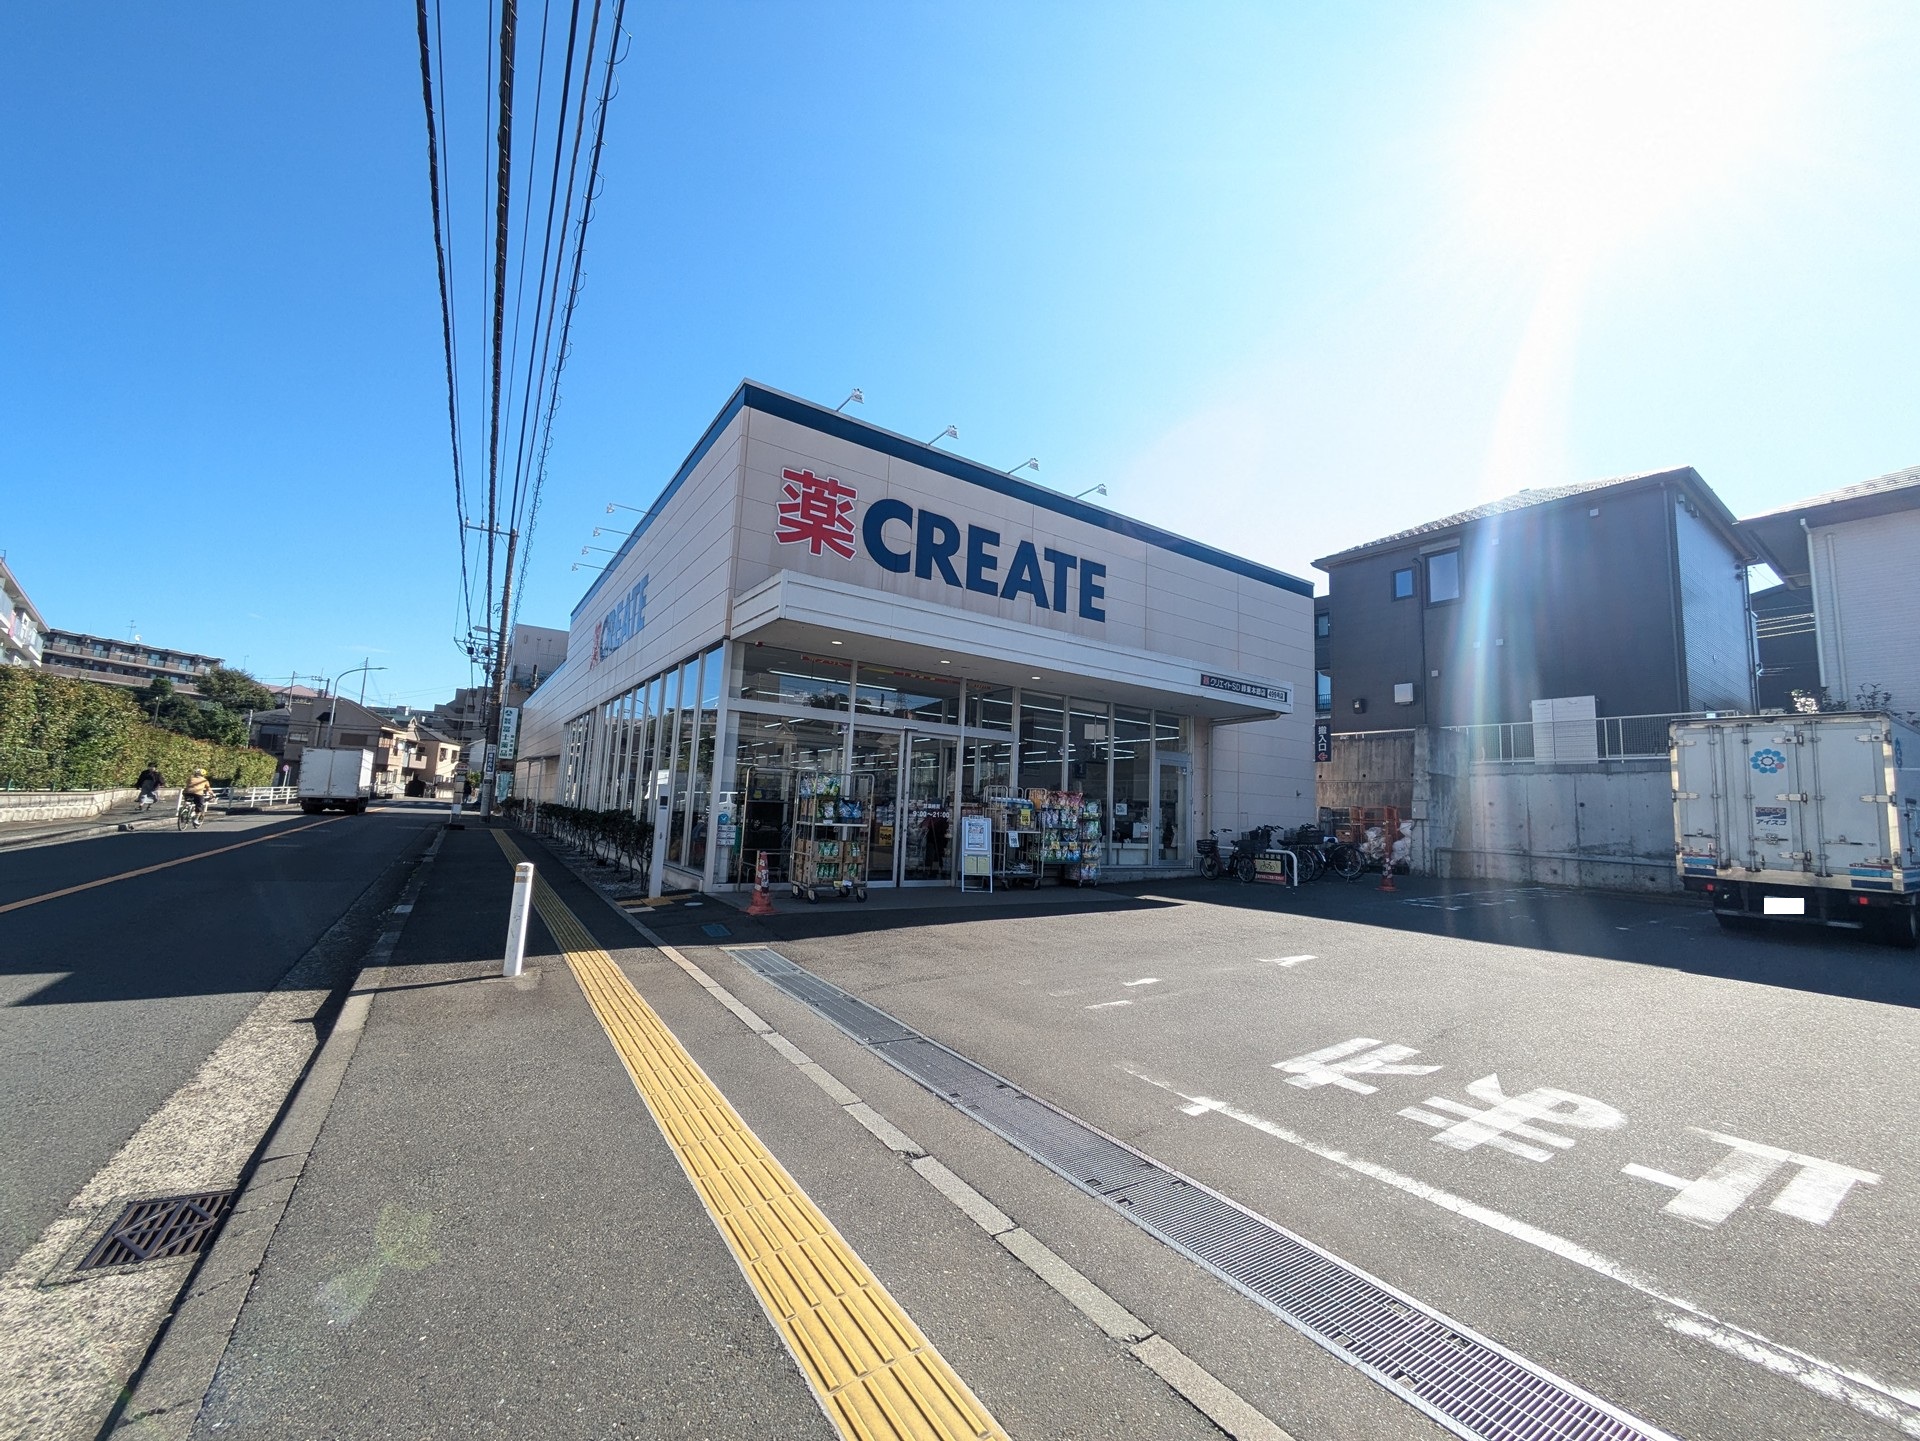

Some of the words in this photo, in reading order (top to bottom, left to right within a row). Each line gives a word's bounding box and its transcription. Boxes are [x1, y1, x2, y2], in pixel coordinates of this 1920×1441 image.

[775, 466, 858, 562] 薬
[862, 497, 1107, 623] CREATE
[600, 573, 650, 663] CREATE
[1318, 726, 1327, 752] 搬入口
